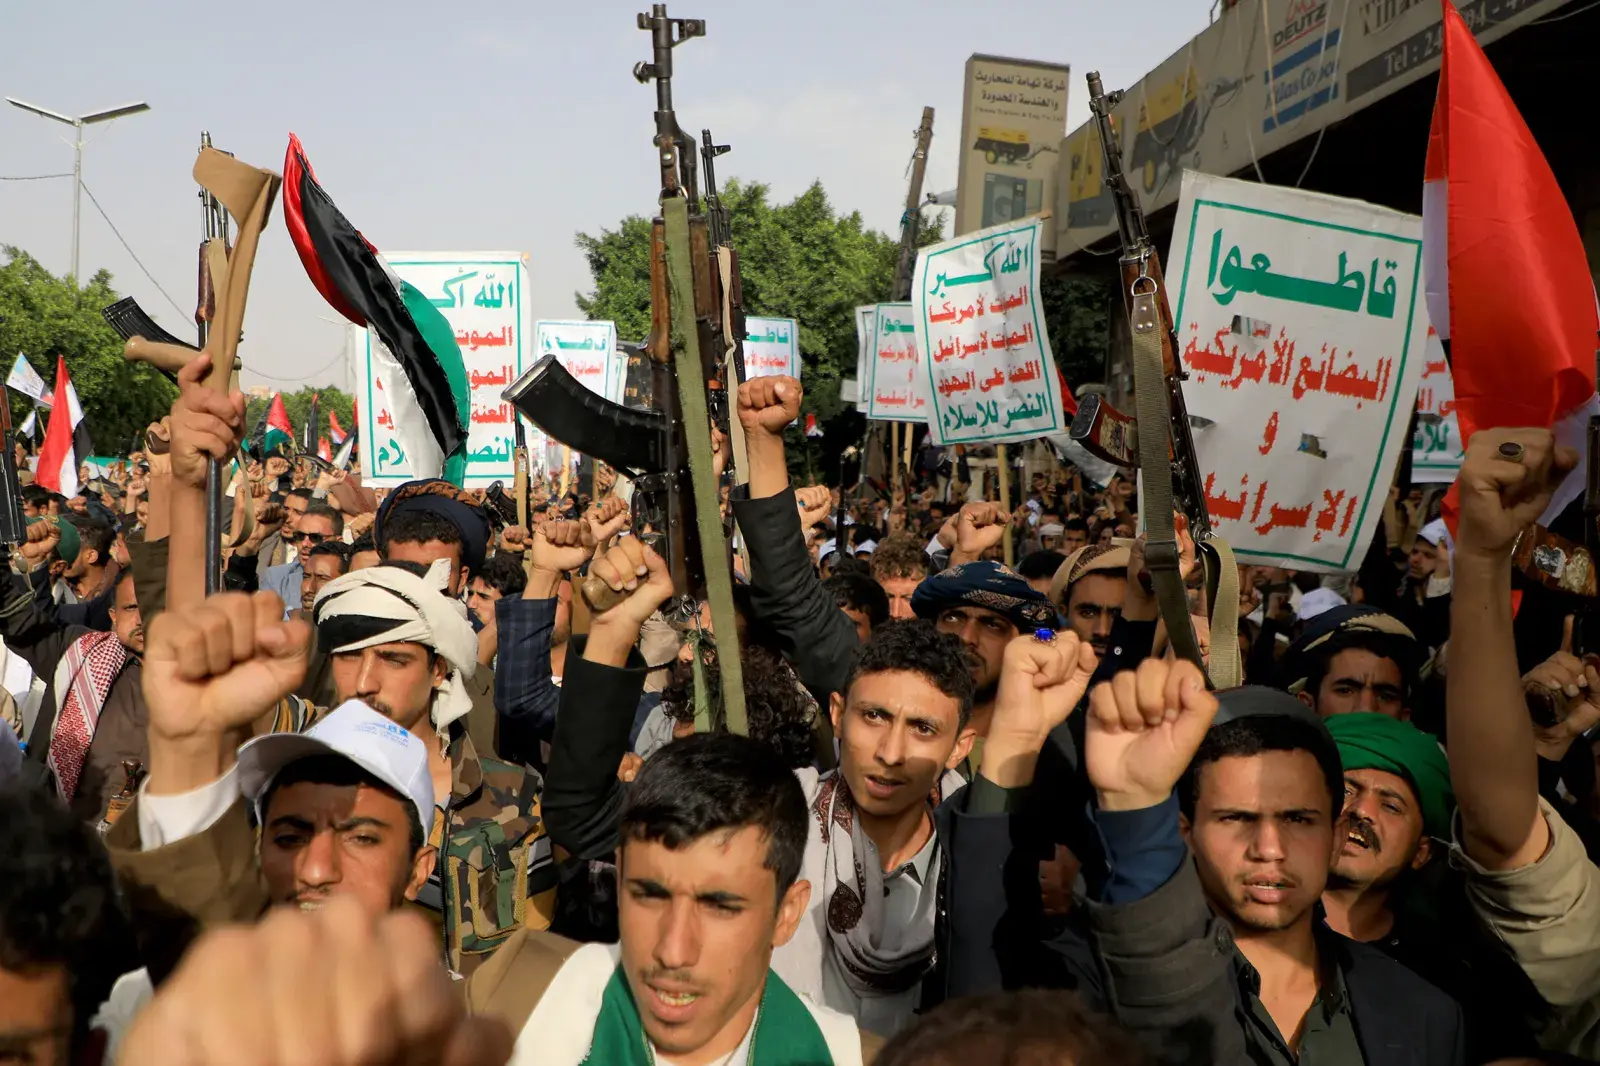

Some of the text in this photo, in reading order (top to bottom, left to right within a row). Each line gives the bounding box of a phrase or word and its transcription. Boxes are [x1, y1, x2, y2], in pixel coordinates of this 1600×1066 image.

[1274, 3, 1326, 47] DEUTZ
[1385, 47, 1408, 76] Tel
[1016, 74, 1041, 89] تهامة
[1042, 77, 1066, 93] شركة
[981, 90, 1059, 111] والهندسة المحدودة
[1207, 228, 1398, 319] قاطعوا
[1183, 321, 1297, 391] الأمريكية
[471, 364, 514, 391] المو
[937, 359, 1041, 399] اللعنة على اليهود
[1292, 341, 1393, 409] البضائع
[471, 402, 515, 424] اللعنة
[1003, 391, 1049, 430] النصر
[466, 434, 515, 463] النص
[1258, 411, 1280, 456] و
